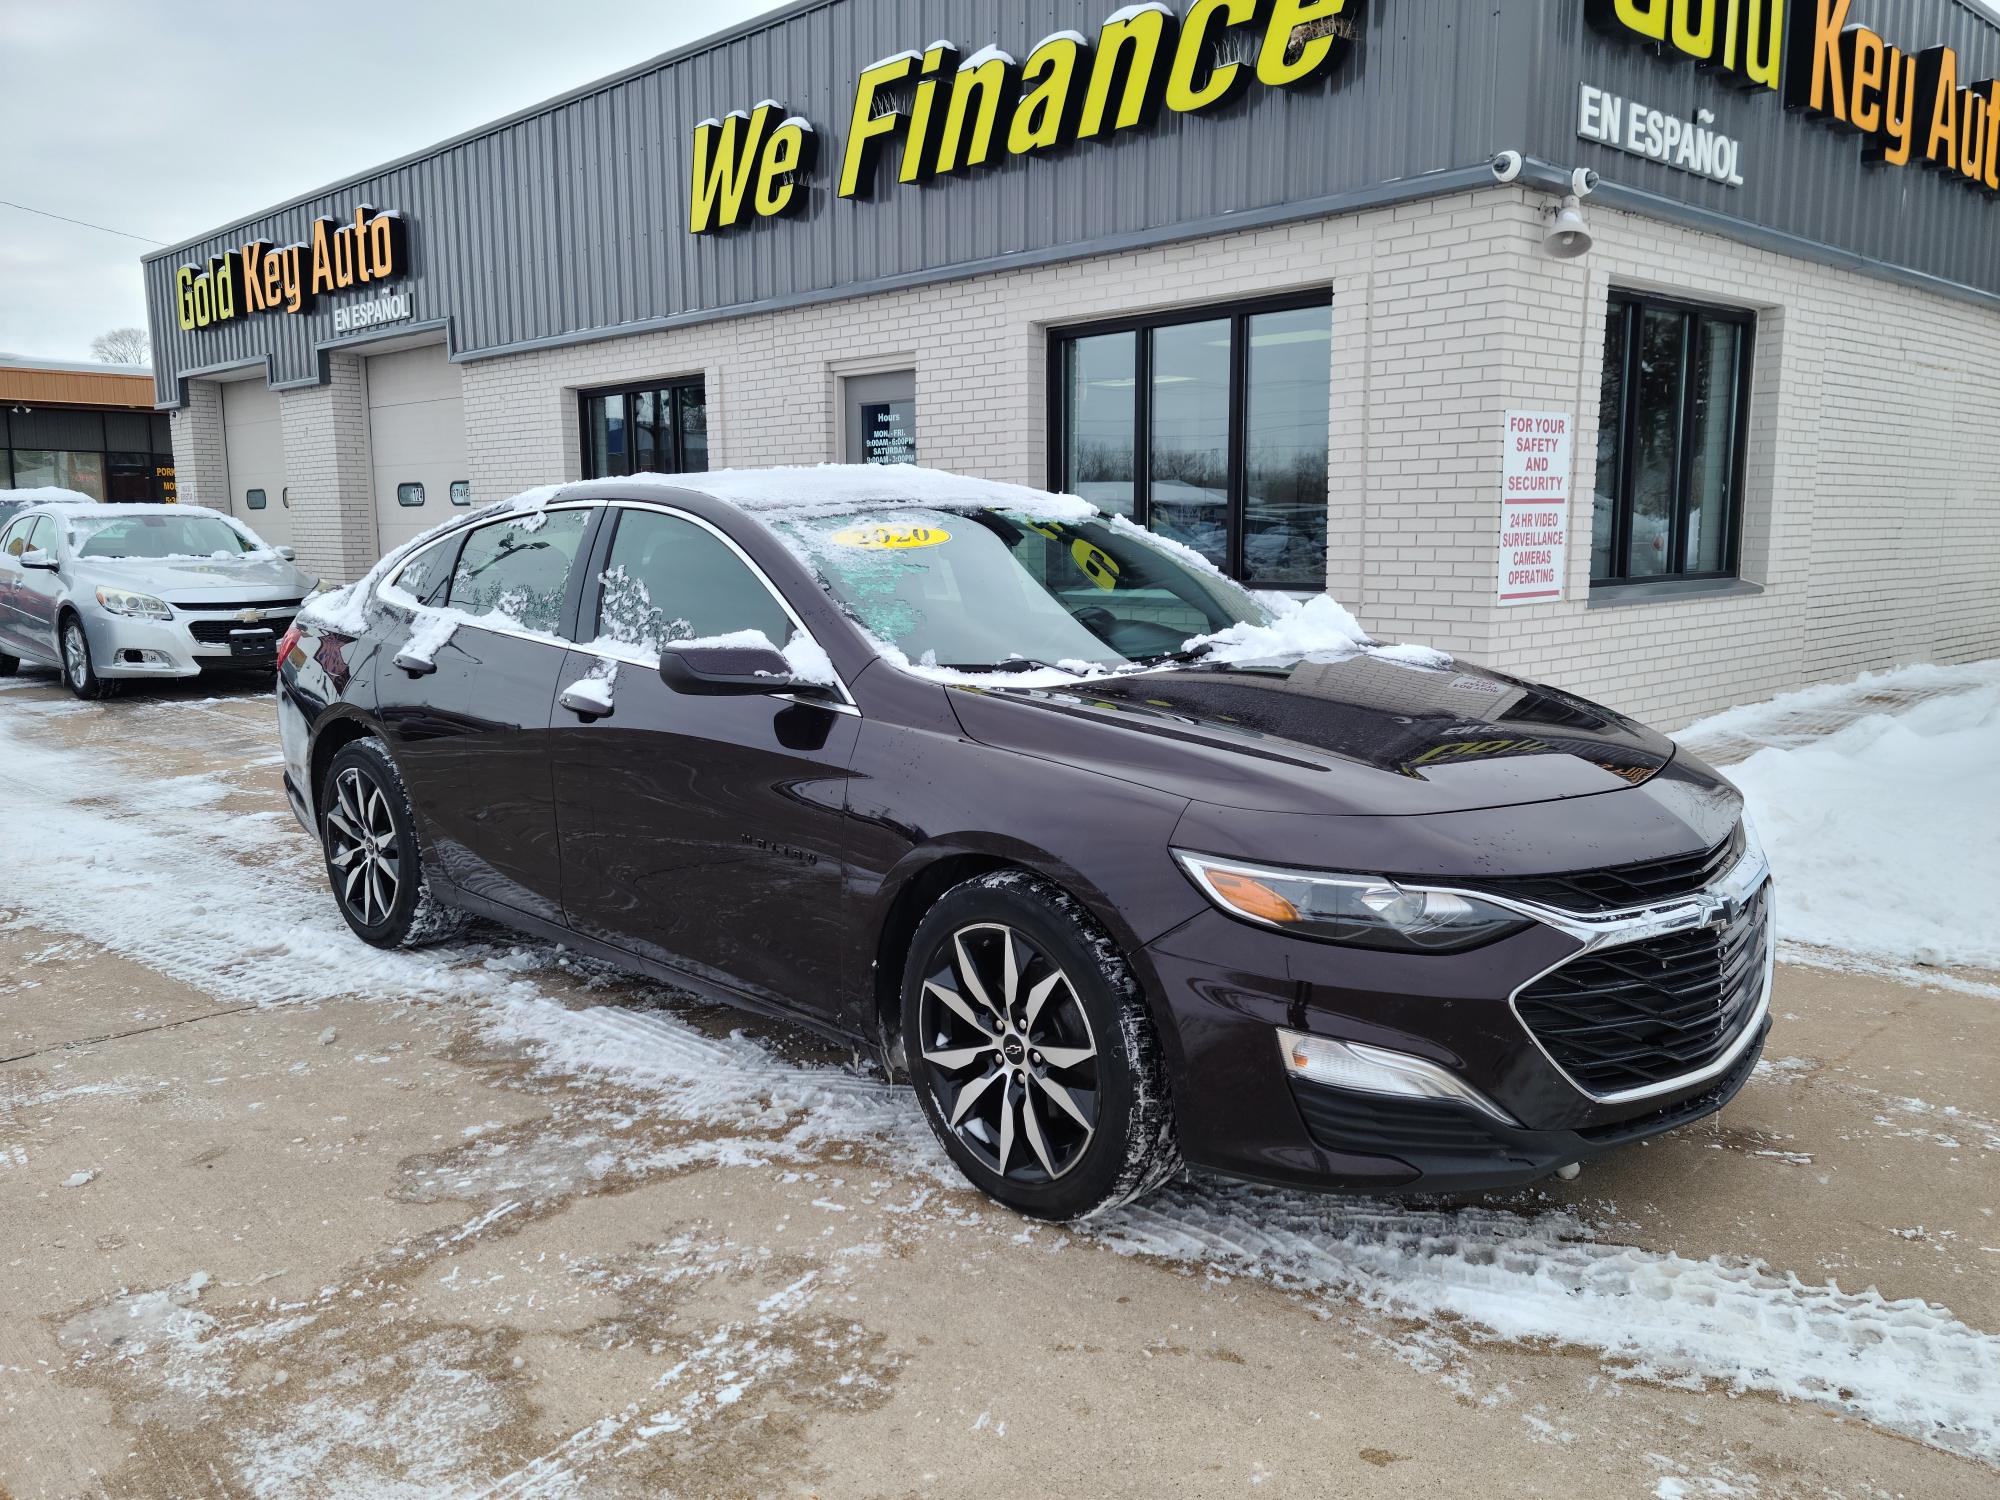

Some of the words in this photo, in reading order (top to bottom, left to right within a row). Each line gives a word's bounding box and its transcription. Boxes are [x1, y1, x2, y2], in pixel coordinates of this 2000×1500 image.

[1613, 0, 1784, 91] old
[1810, 0, 1916, 166] Key
[690, 104, 802, 234] We
[837, 0, 1345, 198] Finance
[1580, 84, 1621, 145] EN
[1627, 102, 1743, 186] ESPAÑOL
[176, 251, 235, 331] Gold
[242, 241, 301, 314] Key
[312, 207, 393, 295] Auto
[335, 306, 352, 331] EN
[353, 287, 411, 327] ESPAÑOL
[877, 413, 900, 422] Hours
[1510, 417, 1533, 433] FOR
[1535, 418, 1565, 434] YOUR
[873, 430, 890, 438] MON.
[893, 428, 906, 437] FRI.
[873, 446, 907, 455] SATURDAY
[1516, 437, 1558, 452] SAFETY
[1525, 457, 1549, 472] AND
[1508, 476, 1563, 491] SECURITY
[1510, 513, 1520, 528] 24
[1521, 513, 1533, 527] HR
[1535, 512, 1558, 527] VIDEO
[859, 527, 930, 544] 00
[1503, 531, 1564, 548] SURVEILLANCE
[1513, 550, 1551, 566] CAMERAS
[1508, 568, 1554, 585] OPERATING
